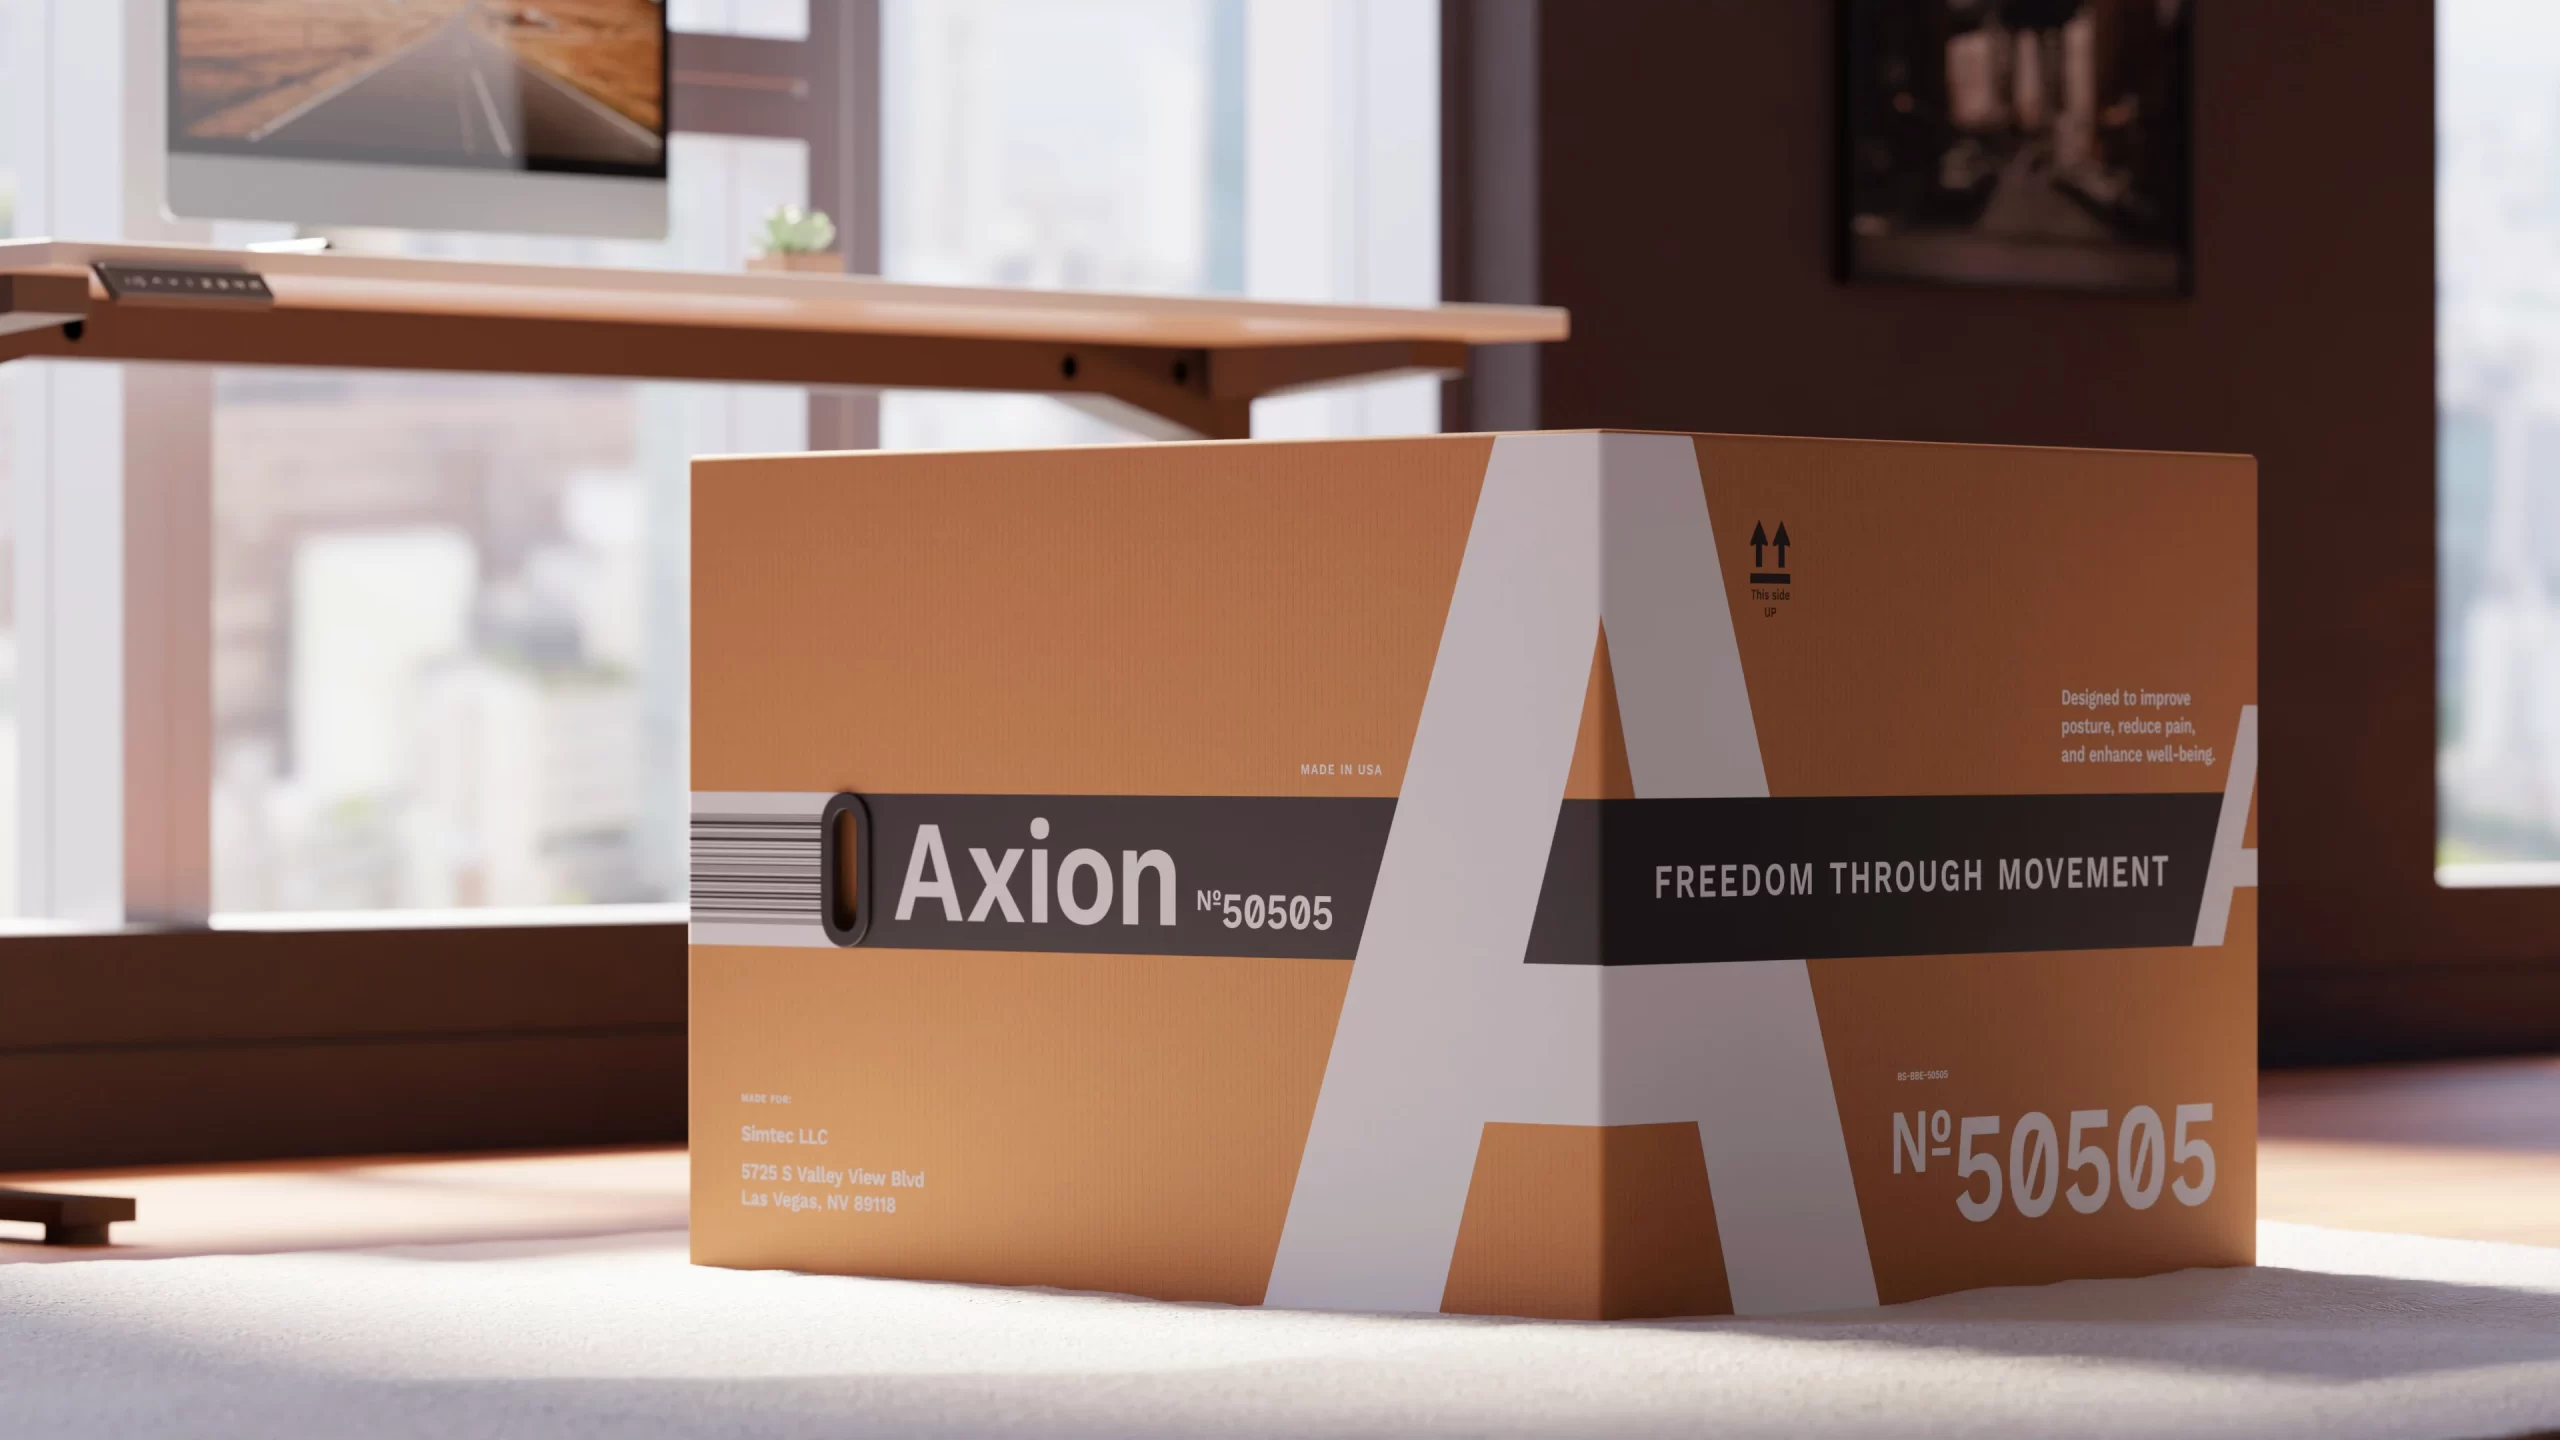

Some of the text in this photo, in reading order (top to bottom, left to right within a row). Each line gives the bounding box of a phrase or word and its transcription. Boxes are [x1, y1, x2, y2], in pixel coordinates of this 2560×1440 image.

[1751, 589, 1790, 601] This side
[1764, 607, 1777, 618] UP
[2061, 688, 2192, 710] Designed to improve
[2061, 716, 2196, 738] posture, reduce pain,
[2061, 745, 2216, 767] and enhance well-being.
[1300, 763, 1383, 776] MADE IN USA
[894, 816, 1177, 927] Axion
[1655, 855, 2169, 899] FREEDOM THROUGH MOVEMENT
[741, 1093, 791, 1104] MADE FOR:
[741, 1124, 829, 1145] Simtec LLC
[741, 1163, 925, 1189] 5725 S Valley View Blvd
[741, 1189, 896, 1214] Las Vegas, NV 89118
